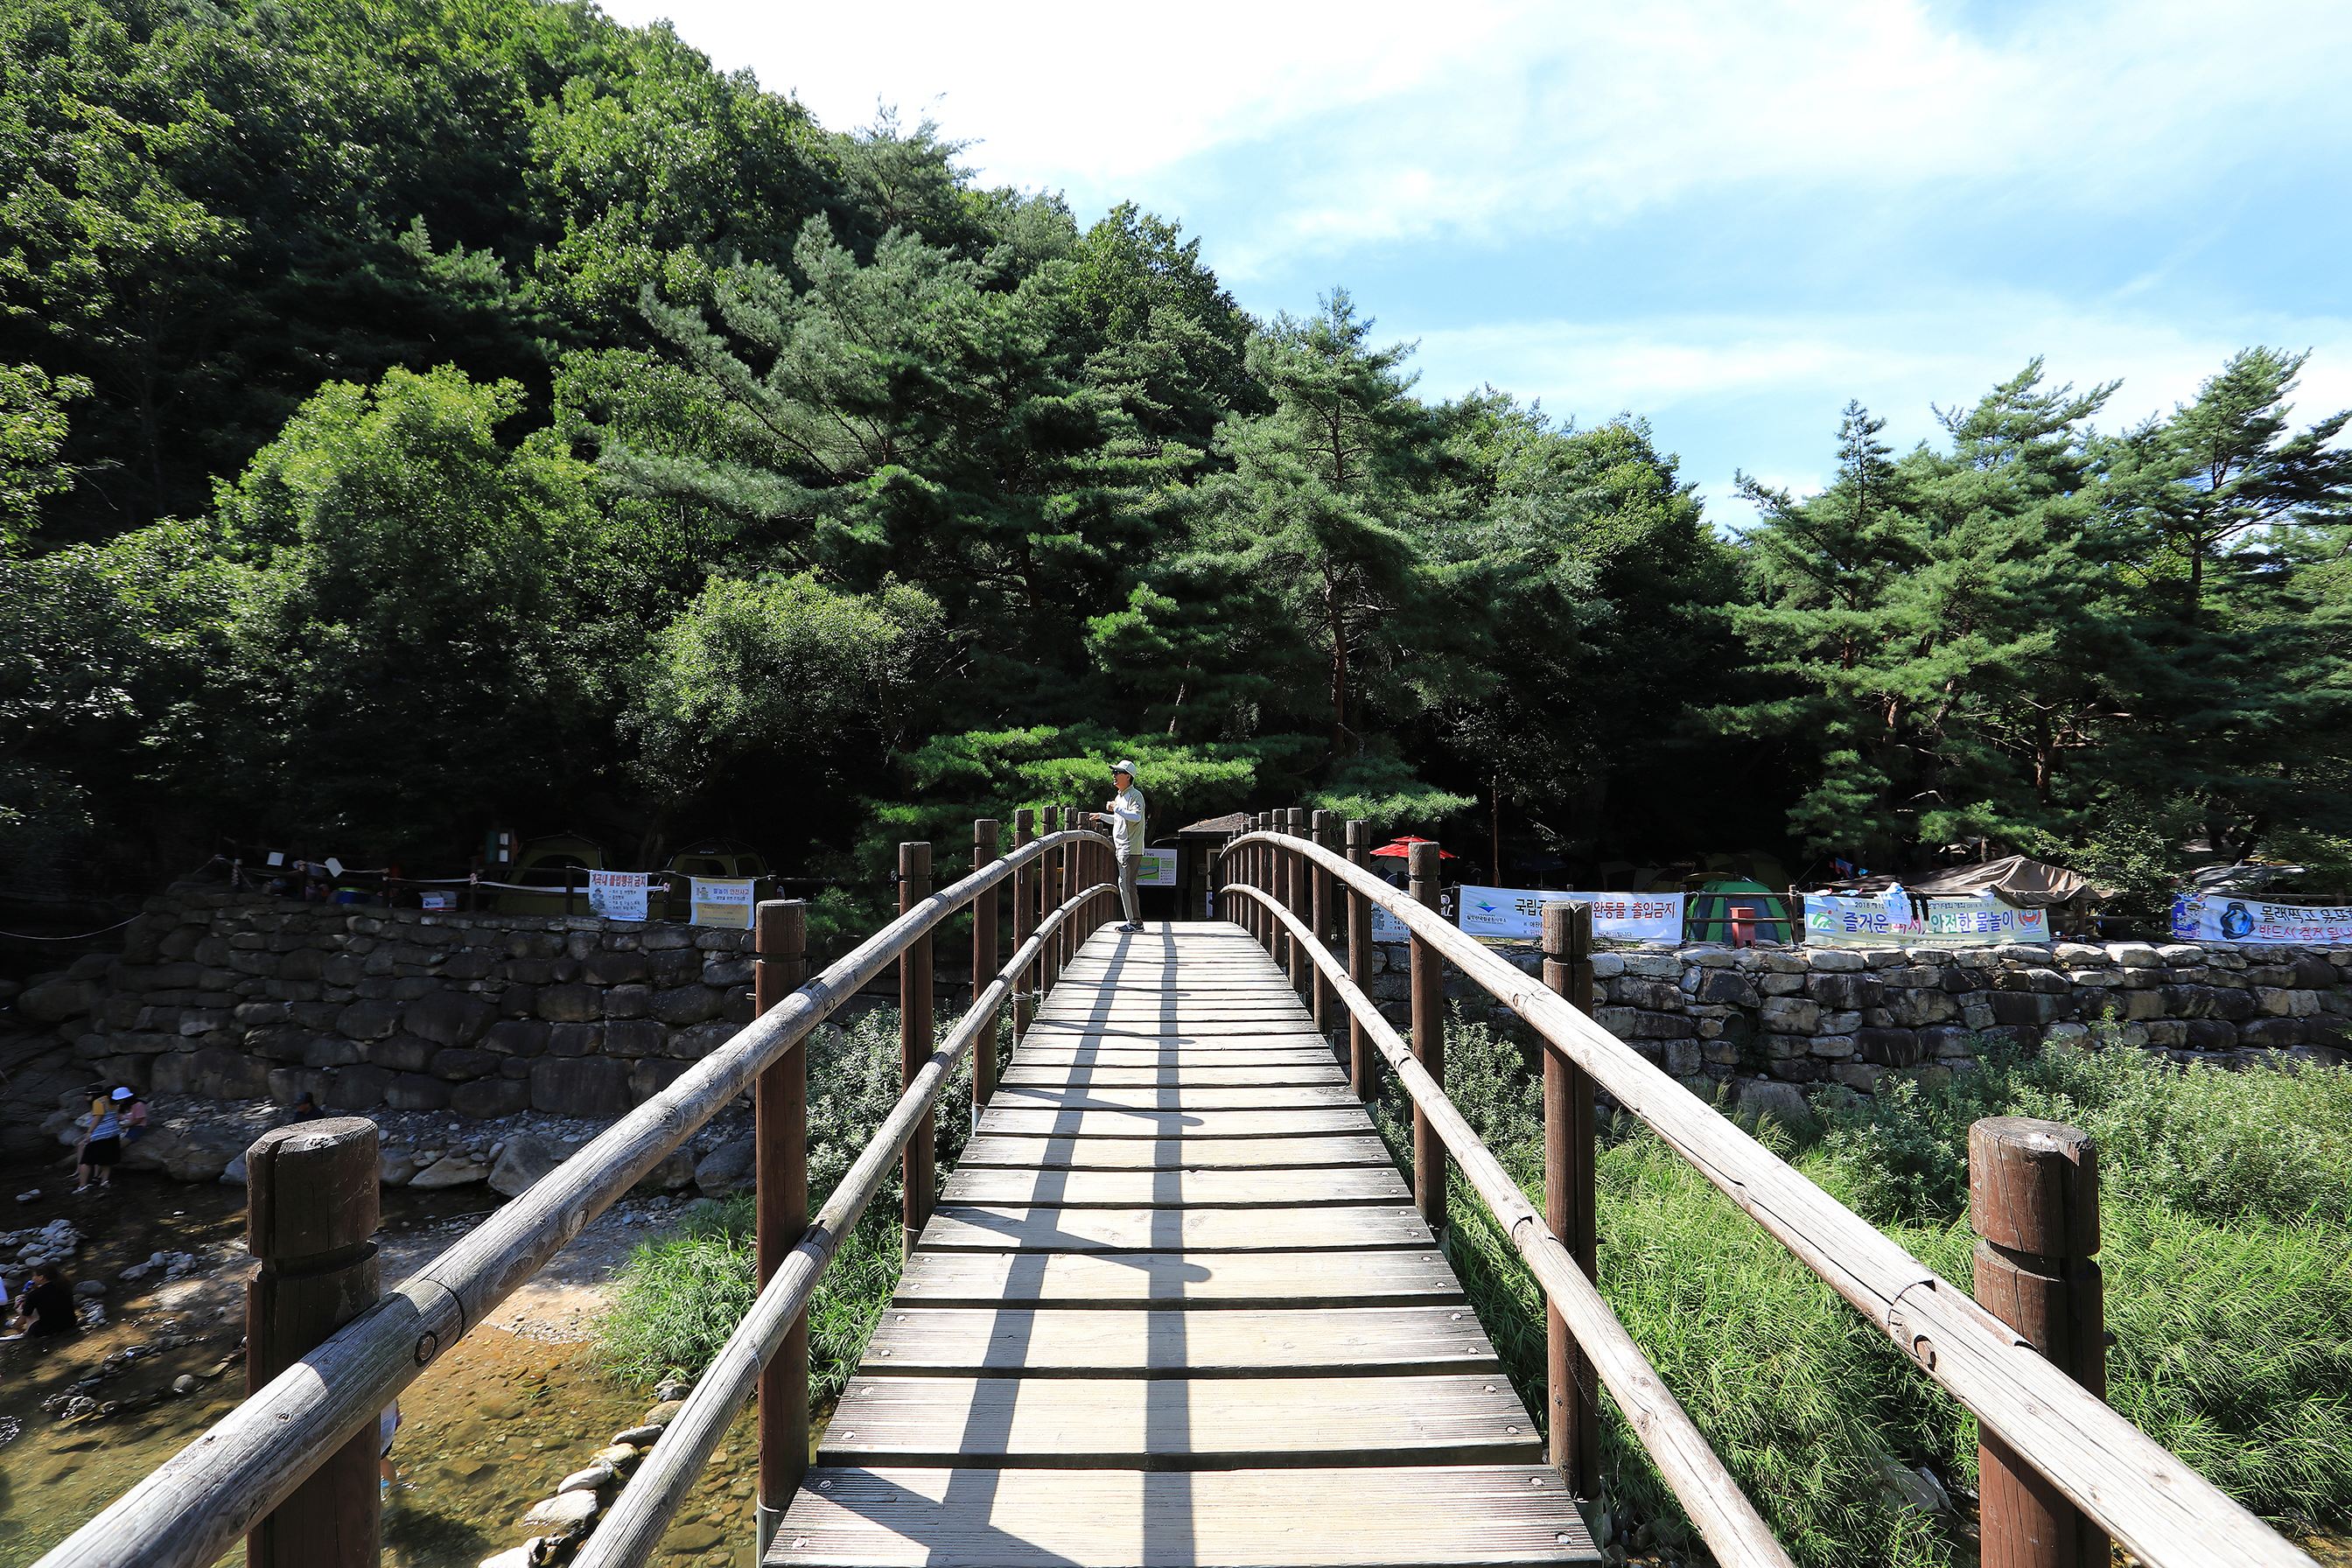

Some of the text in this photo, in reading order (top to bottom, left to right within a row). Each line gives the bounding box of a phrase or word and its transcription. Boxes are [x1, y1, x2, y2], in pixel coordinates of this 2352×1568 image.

[592, 873, 647, 887] 계곡내 불법행위 금지
[1588, 901, 1626, 919] 완동물
[1631, 901, 1676, 919] 출입금지
[2260, 906, 2319, 924] 몰래찍고
[1843, 912, 1889, 934] 즐거운
[1930, 913, 1971, 934] 안전한
[1976, 910, 2014, 934] 물놀이
[2259, 924, 2297, 940] 반드시
[2299, 926, 2325, 941] 검거
